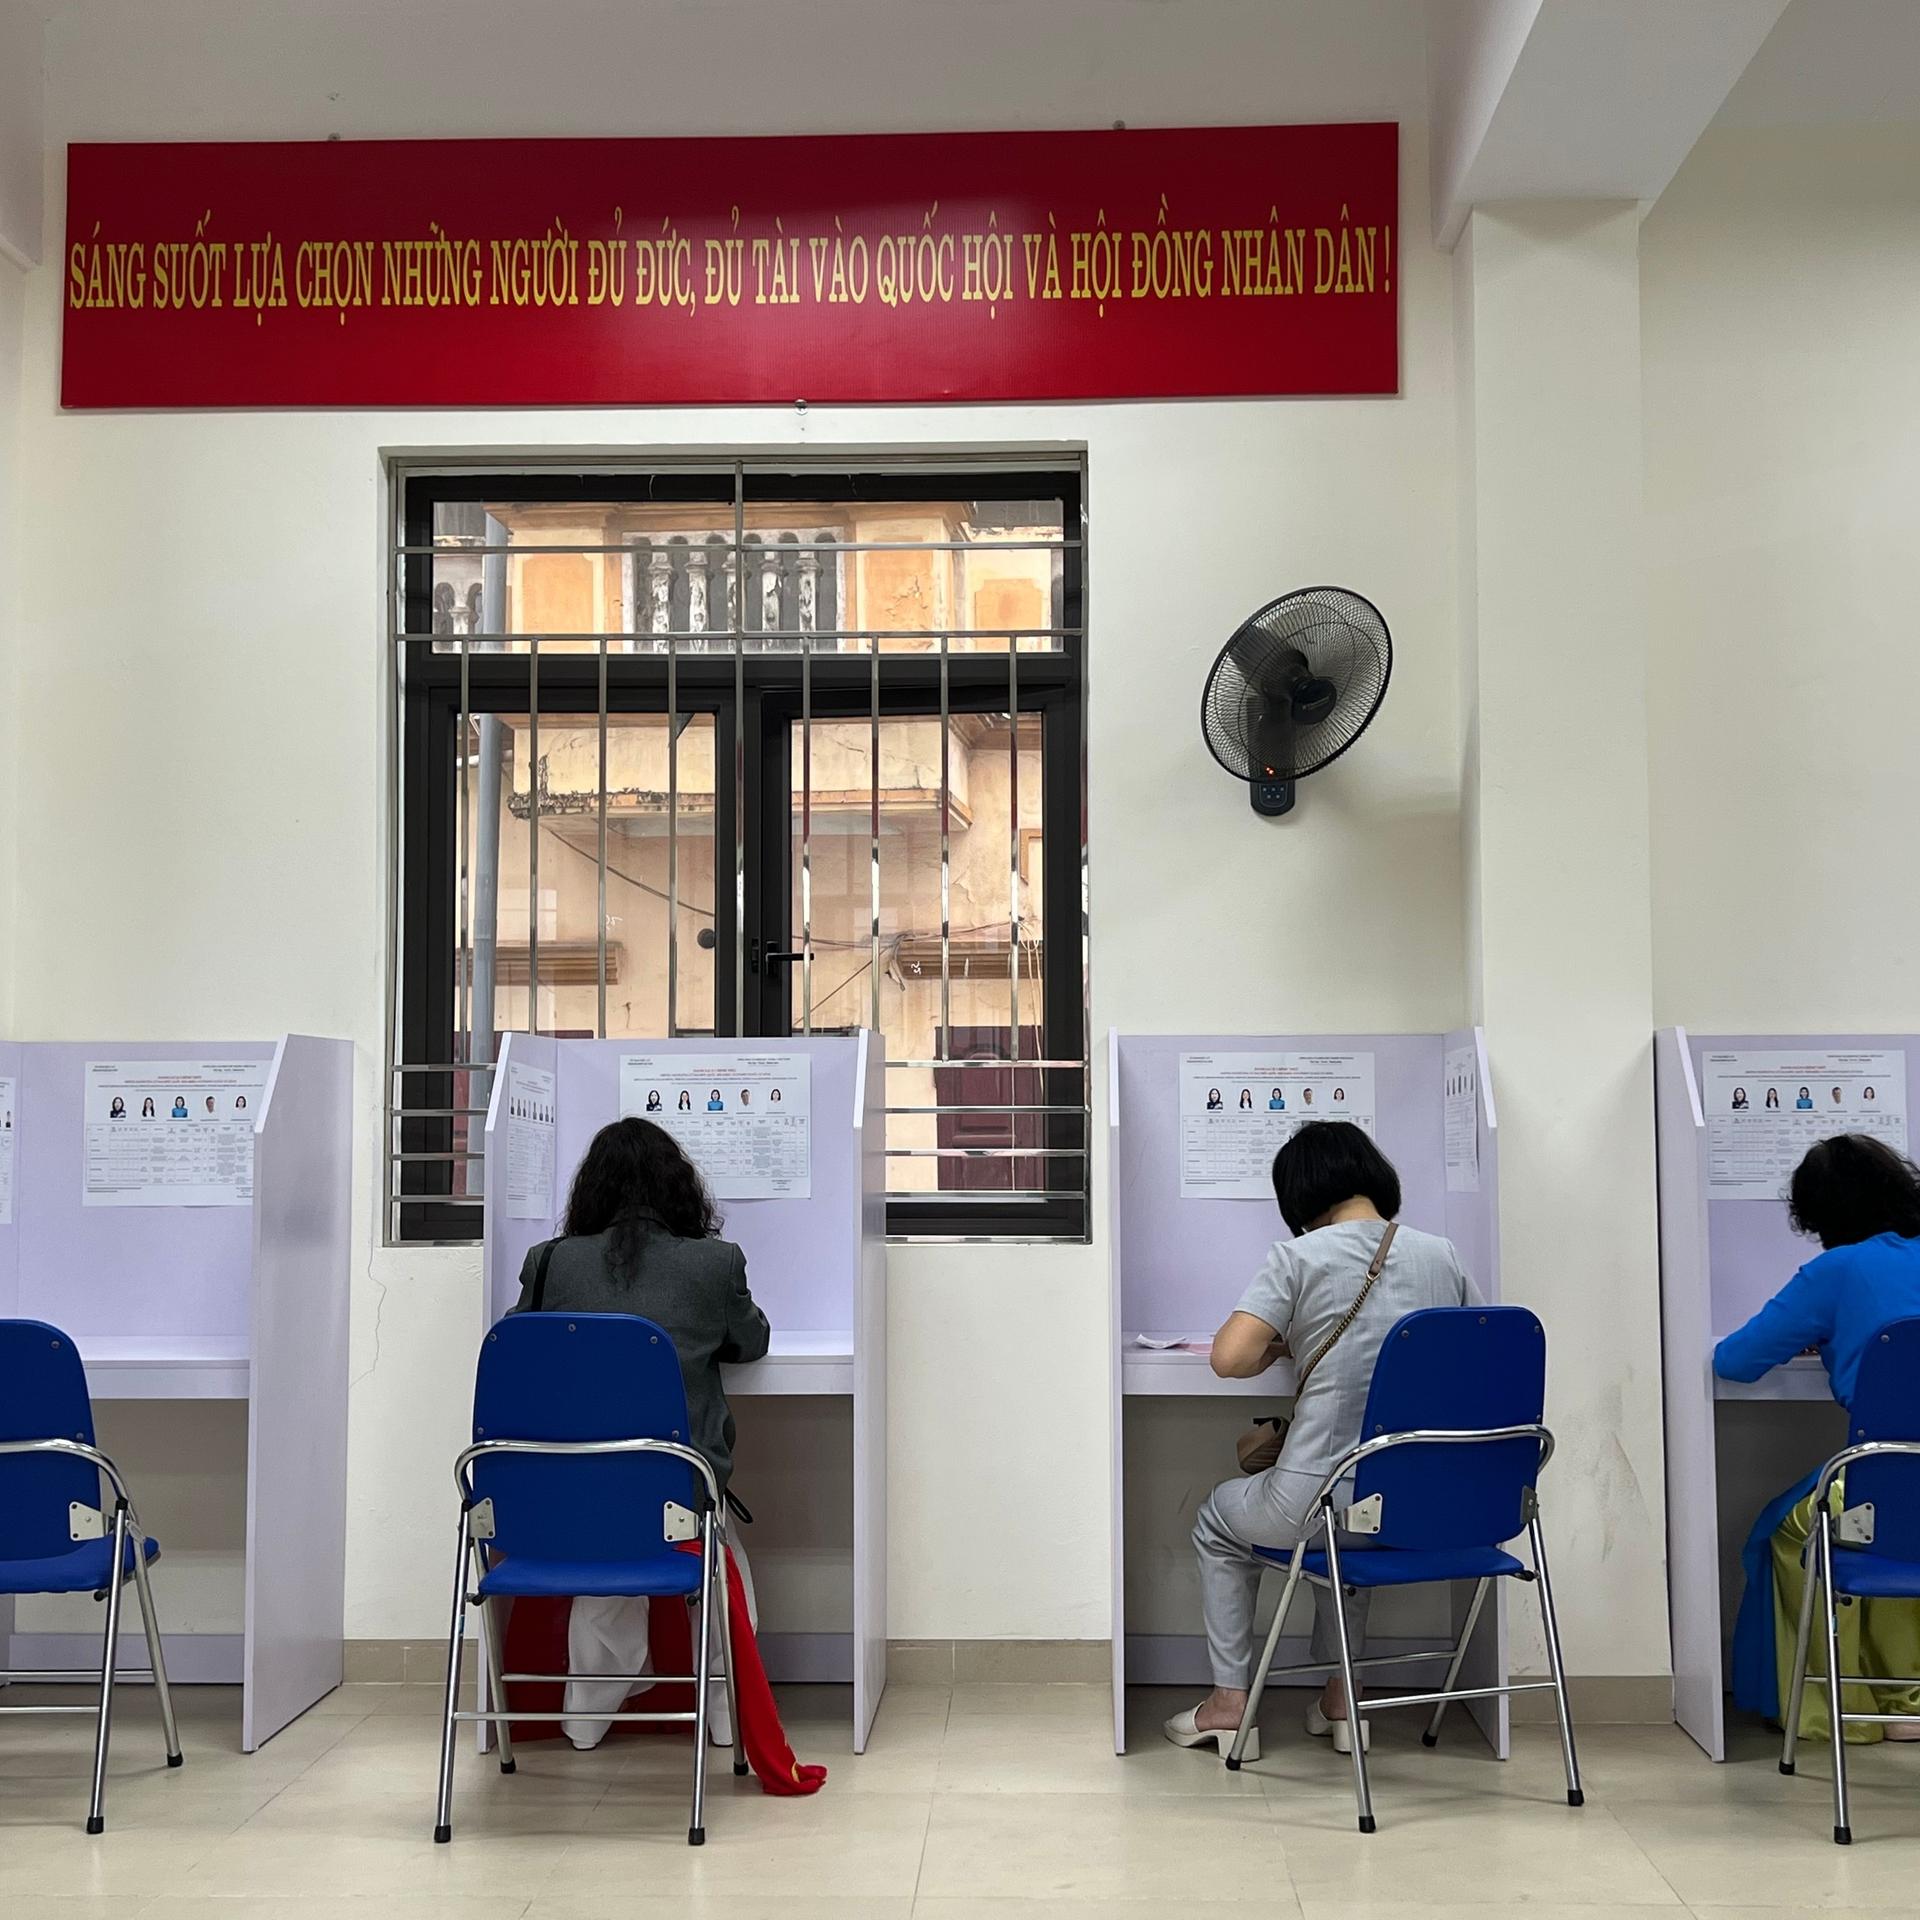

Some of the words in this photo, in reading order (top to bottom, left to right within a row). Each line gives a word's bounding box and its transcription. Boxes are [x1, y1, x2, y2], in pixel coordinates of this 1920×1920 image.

[70, 221, 146, 309] SÁNG
[153, 209, 226, 309] SUỐT
[233, 231, 288, 326] LỰA
[296, 240, 374, 326] CHỌN
[379, 220, 483, 307] NHỮNG
[489, 215, 579, 306] NGƯỜI
[588, 206, 627, 306] ĐỦ
[636, 216, 696, 317] ĐỨC,
[704, 205, 744, 306] ĐỦ
[752, 216, 800, 304] TÀI
[809, 215, 869, 304] VÀO
[877, 200, 955, 308] QUỐC
[962, 210, 1013, 320] HỘI
[1022, 210, 1062, 299] VÀ
[1070, 208, 1122, 318] HỘI
[1131, 193, 1214, 299] ĐỒNG
[1221, 205, 1306, 296] NHÂN
